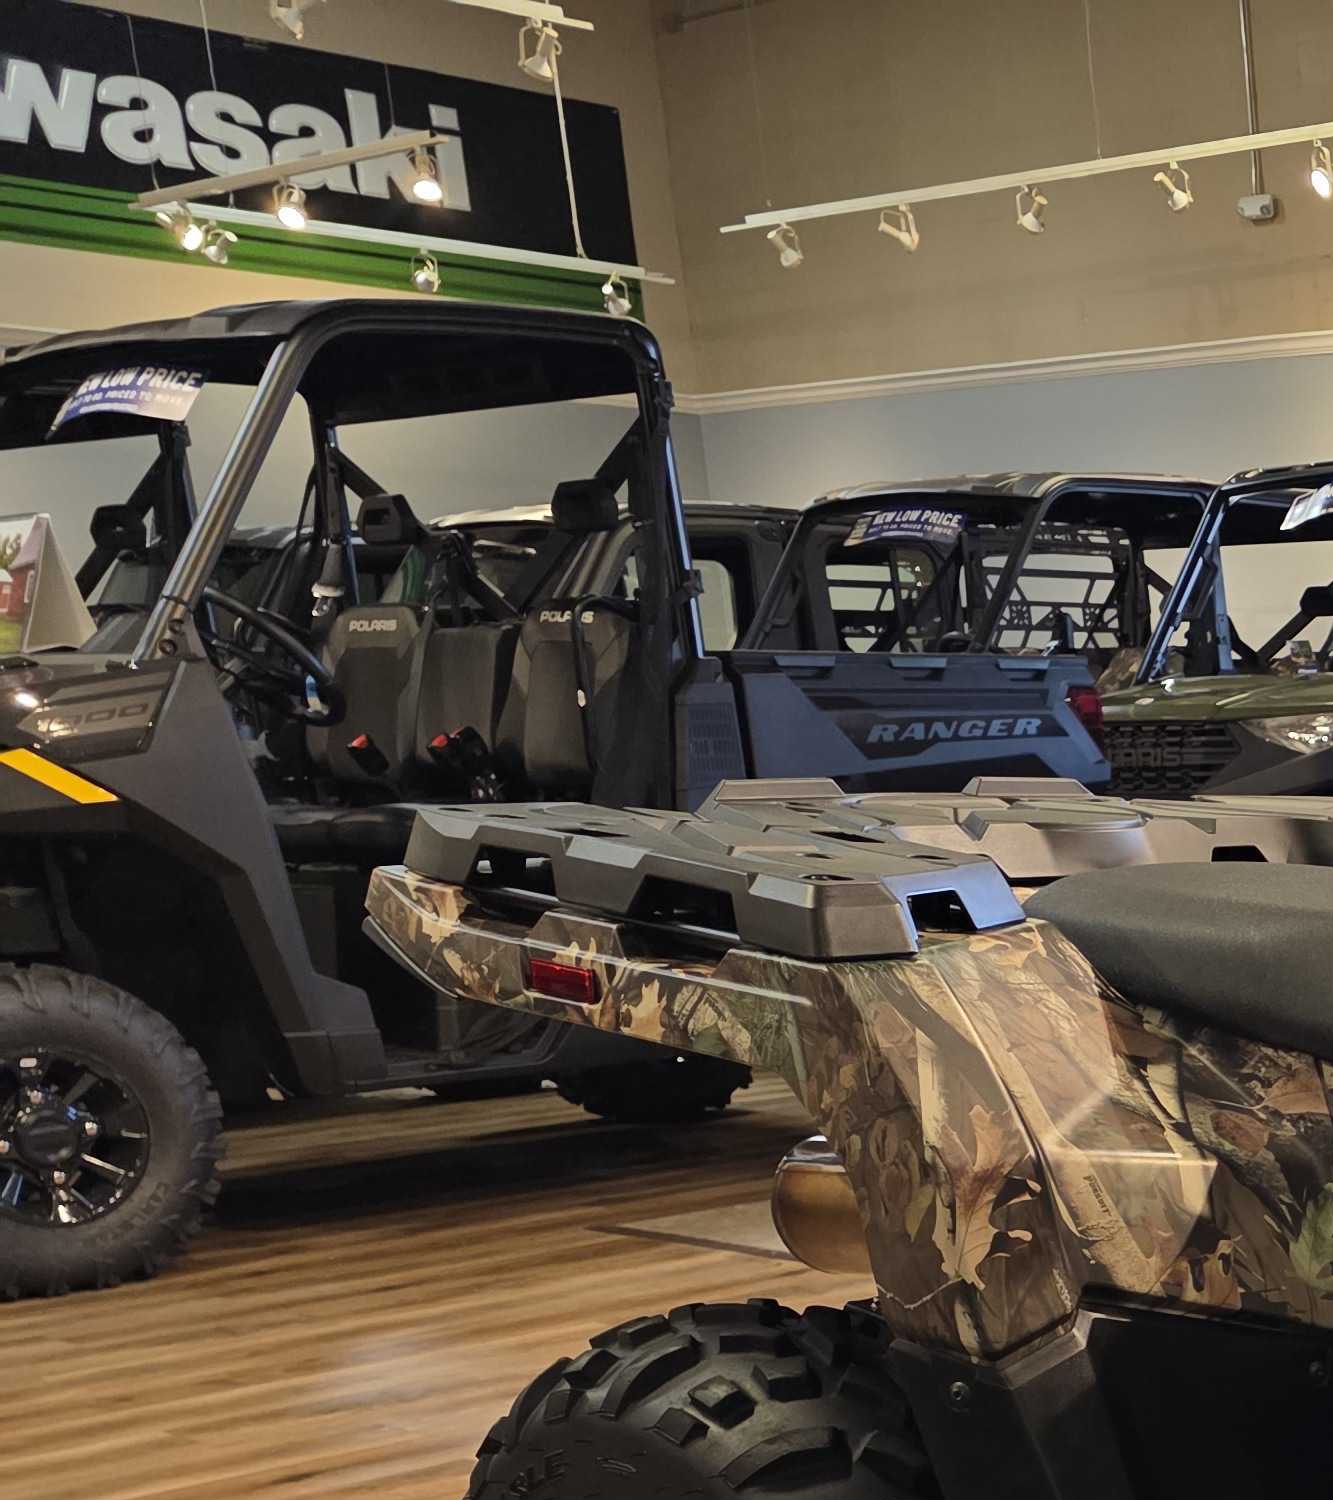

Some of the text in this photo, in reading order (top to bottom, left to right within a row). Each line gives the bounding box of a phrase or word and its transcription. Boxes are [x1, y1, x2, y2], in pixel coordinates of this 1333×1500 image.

[101, 367, 139, 388] LOW
[137, 367, 202, 391] PRICE
[895, 509, 922, 522] LOW
[921, 509, 962, 528] PRICE
[349, 619, 398, 633] POLARIS
[866, 717, 1043, 743] RANGER
